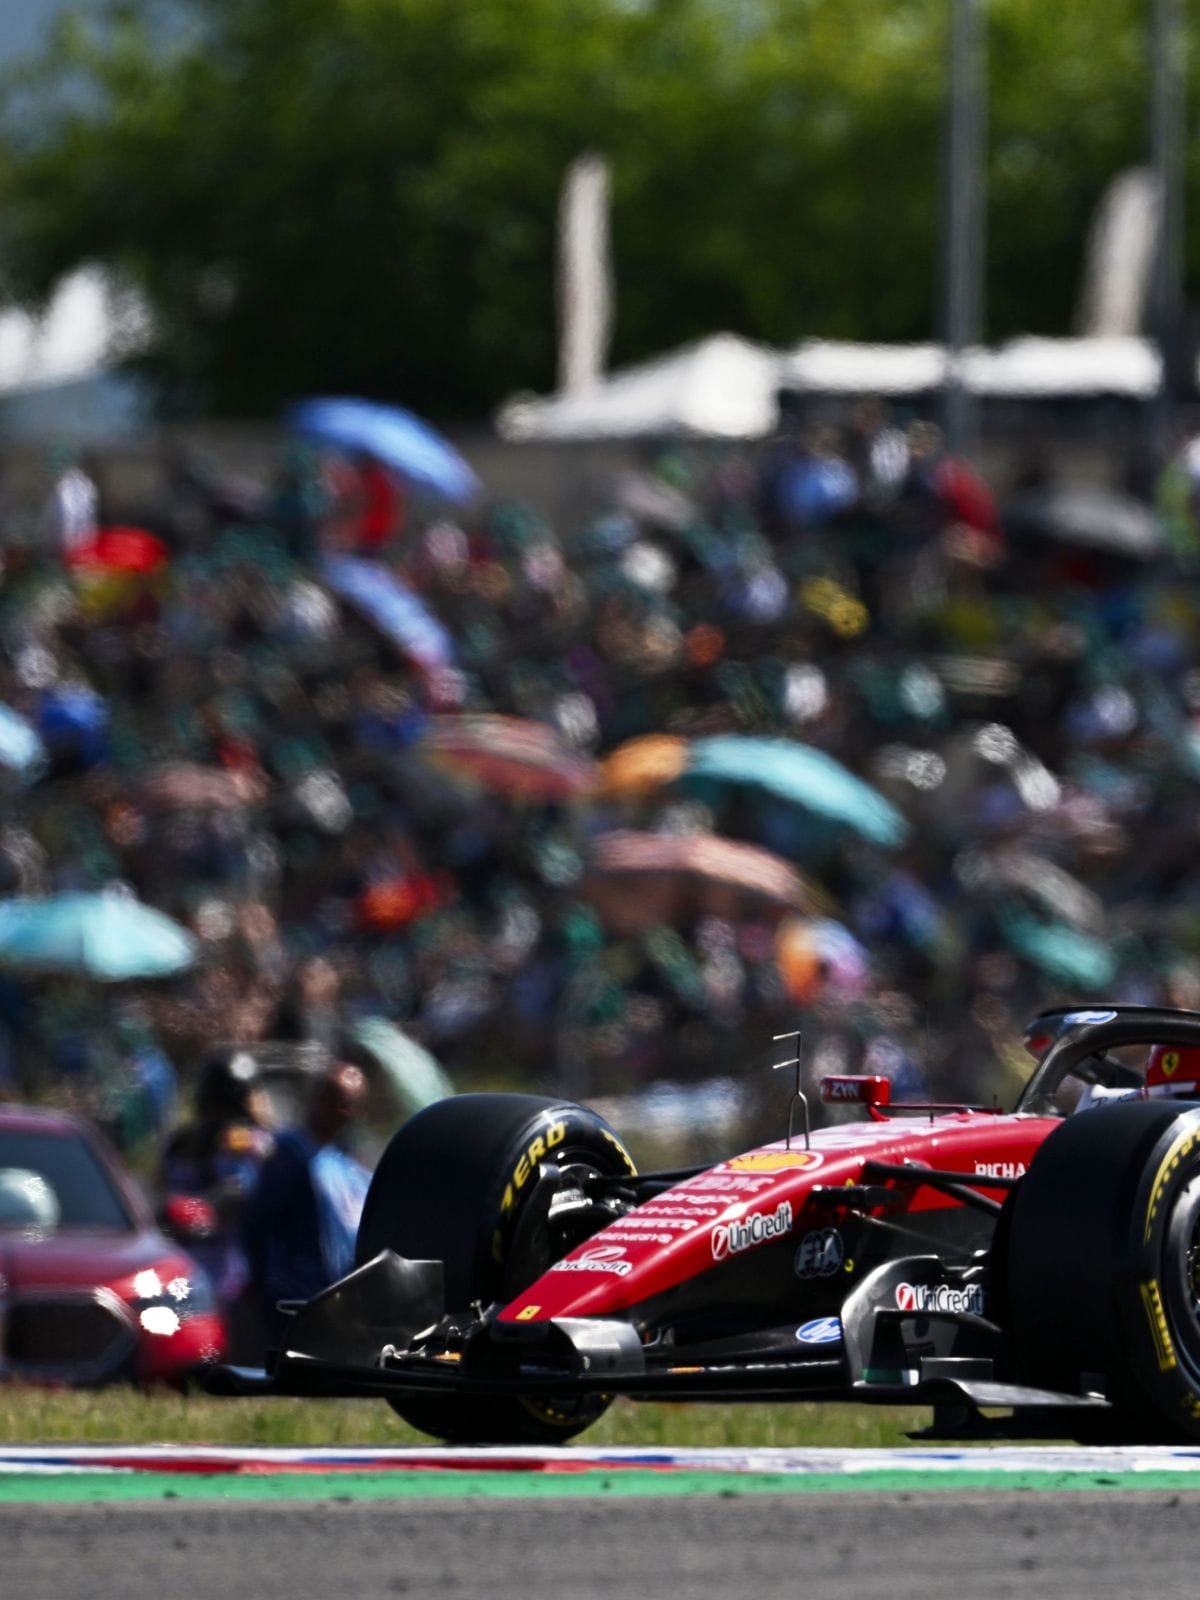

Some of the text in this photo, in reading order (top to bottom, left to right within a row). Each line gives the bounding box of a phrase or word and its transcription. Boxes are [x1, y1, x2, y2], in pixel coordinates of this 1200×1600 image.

[831, 1083, 859, 1097] ZYN
[727, 1202, 792, 1252] UniCredit
[800, 1231, 843, 1267] FIA
[914, 1283, 983, 1315] UniCredit
